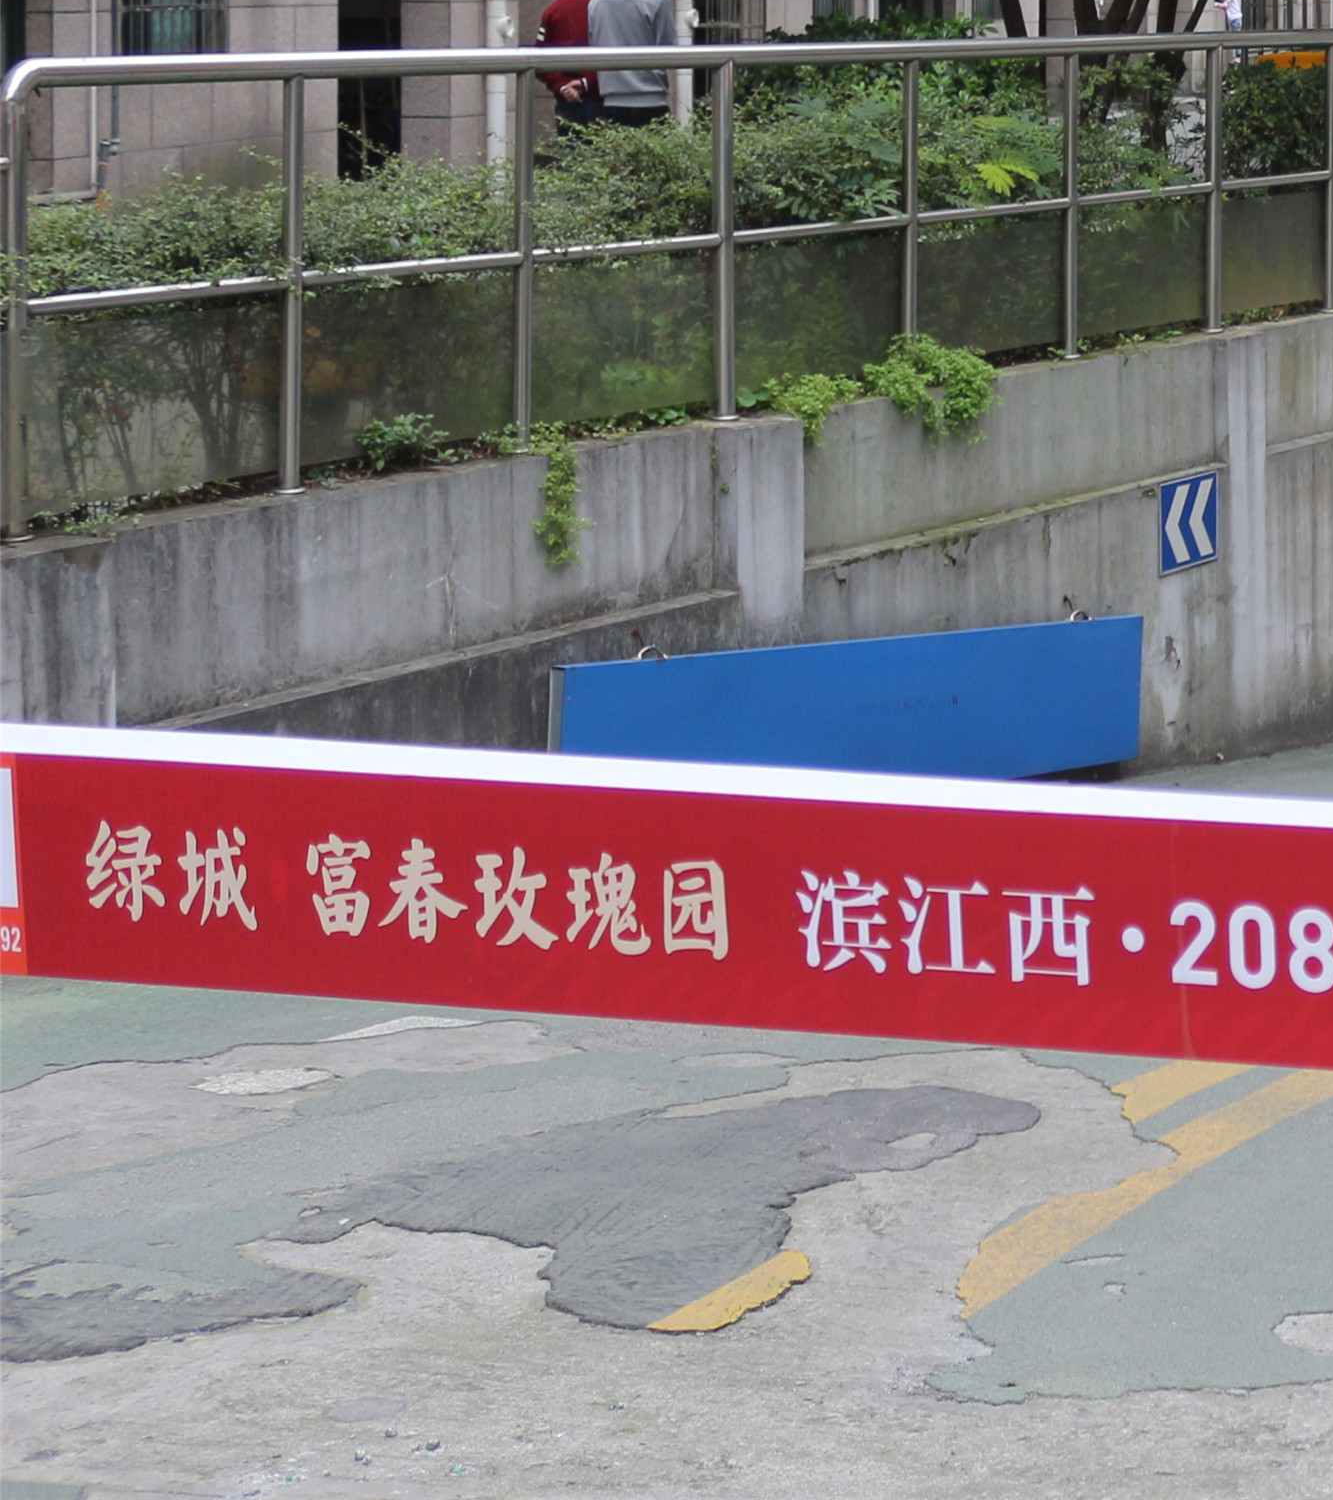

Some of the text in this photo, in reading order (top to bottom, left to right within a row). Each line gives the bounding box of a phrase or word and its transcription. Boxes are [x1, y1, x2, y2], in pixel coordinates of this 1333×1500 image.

[85, 819, 257, 931] 绿城
[307, 832, 729, 961] 富春玫瑰园
